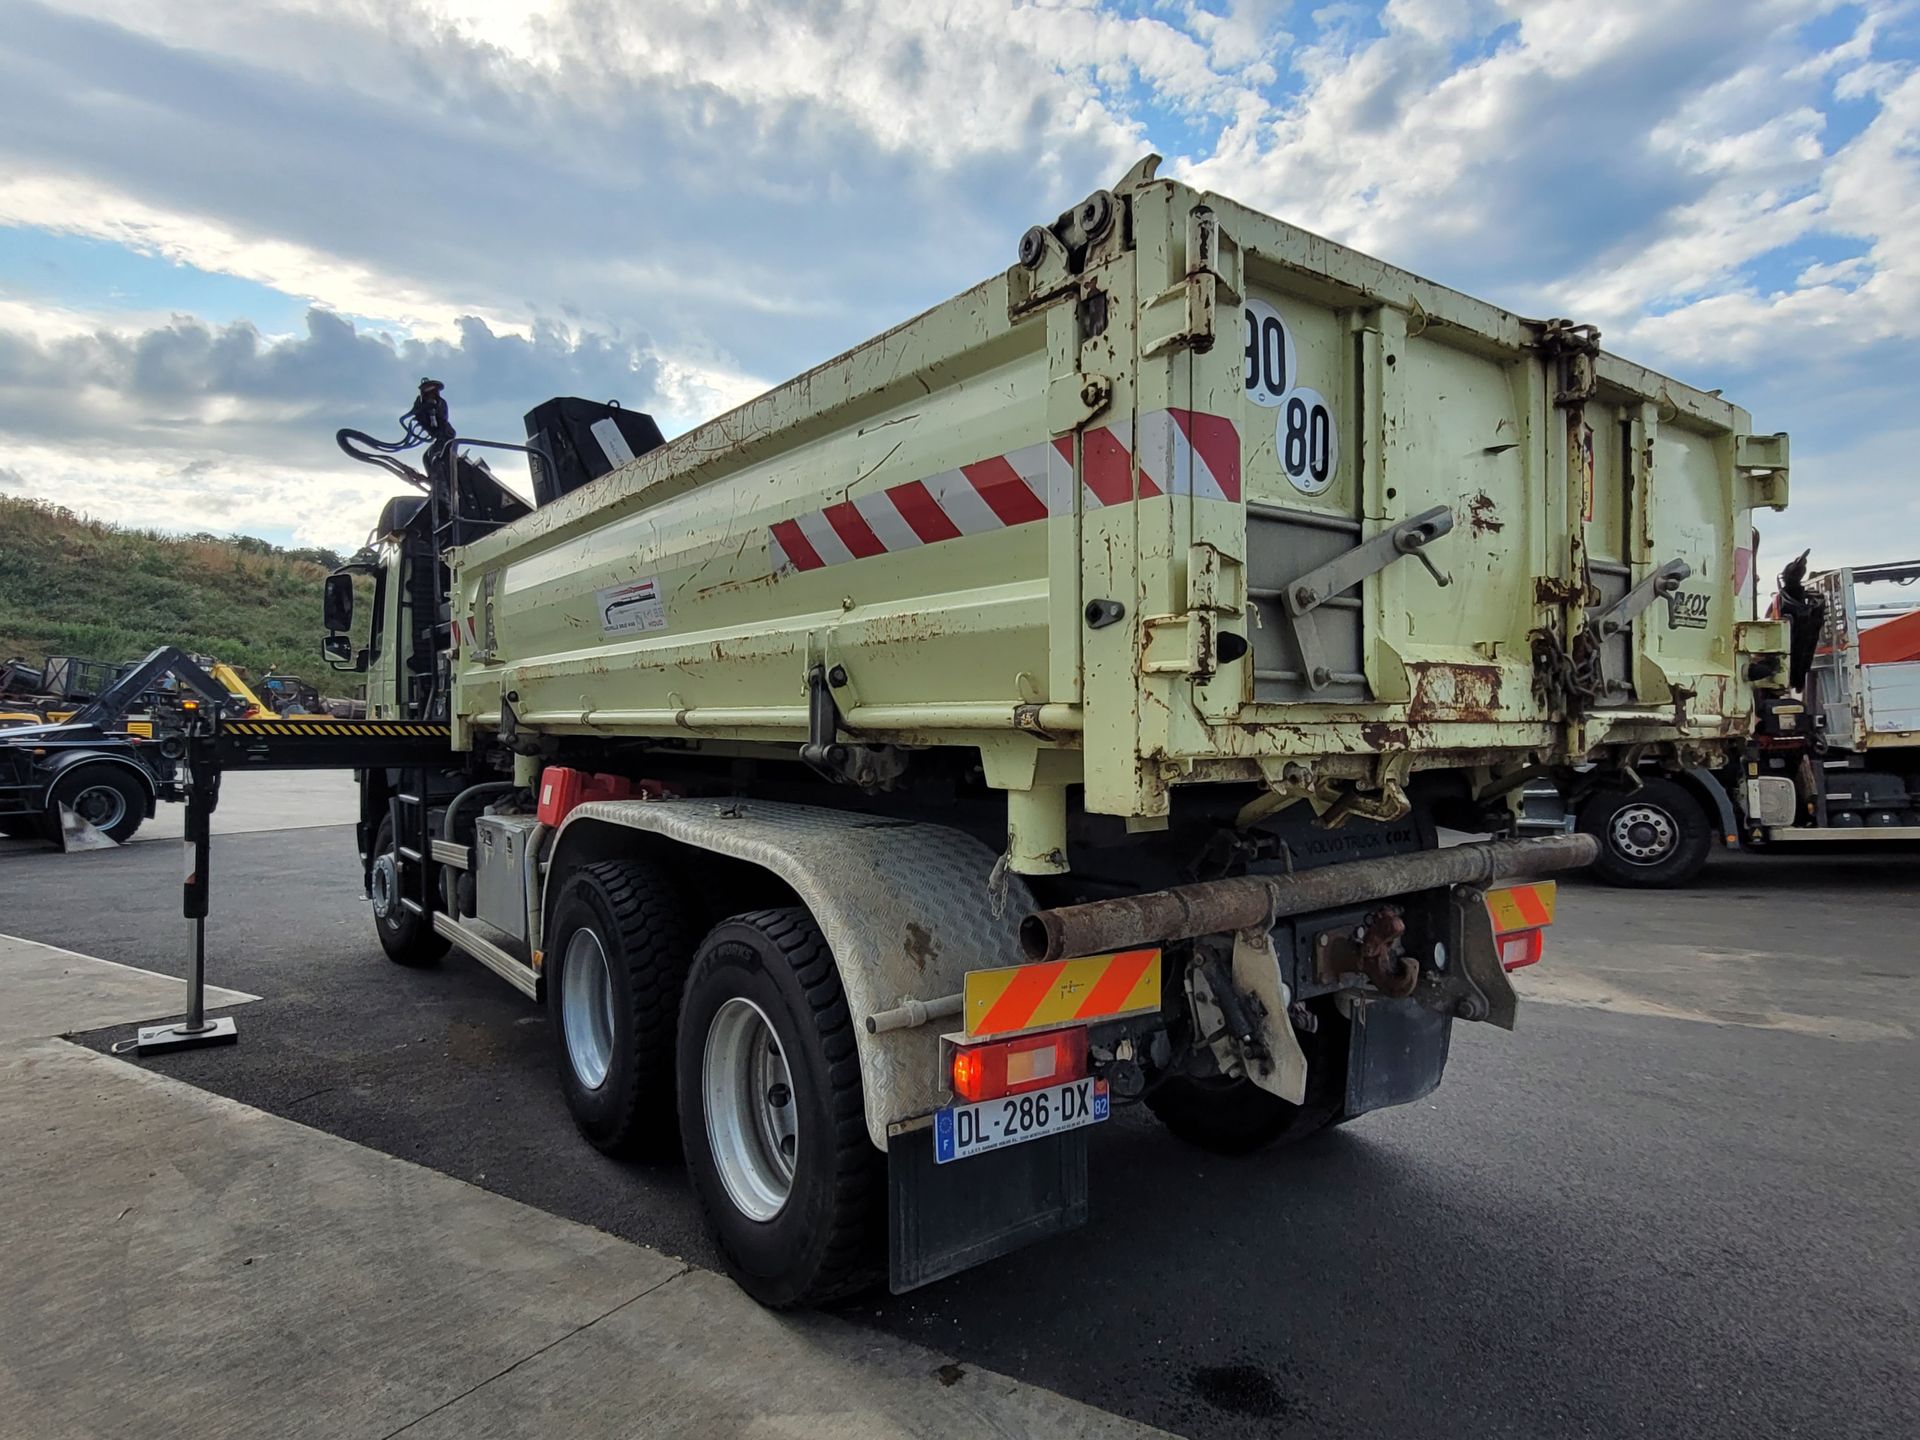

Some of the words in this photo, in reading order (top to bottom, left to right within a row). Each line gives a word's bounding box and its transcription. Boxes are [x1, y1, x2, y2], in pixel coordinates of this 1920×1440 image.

[1285, 397, 1329, 482] 80
[957, 1082, 1090, 1148] DL-286-DX
[1094, 1098, 1107, 1115] 82
[943, 1139, 950, 1151] F
